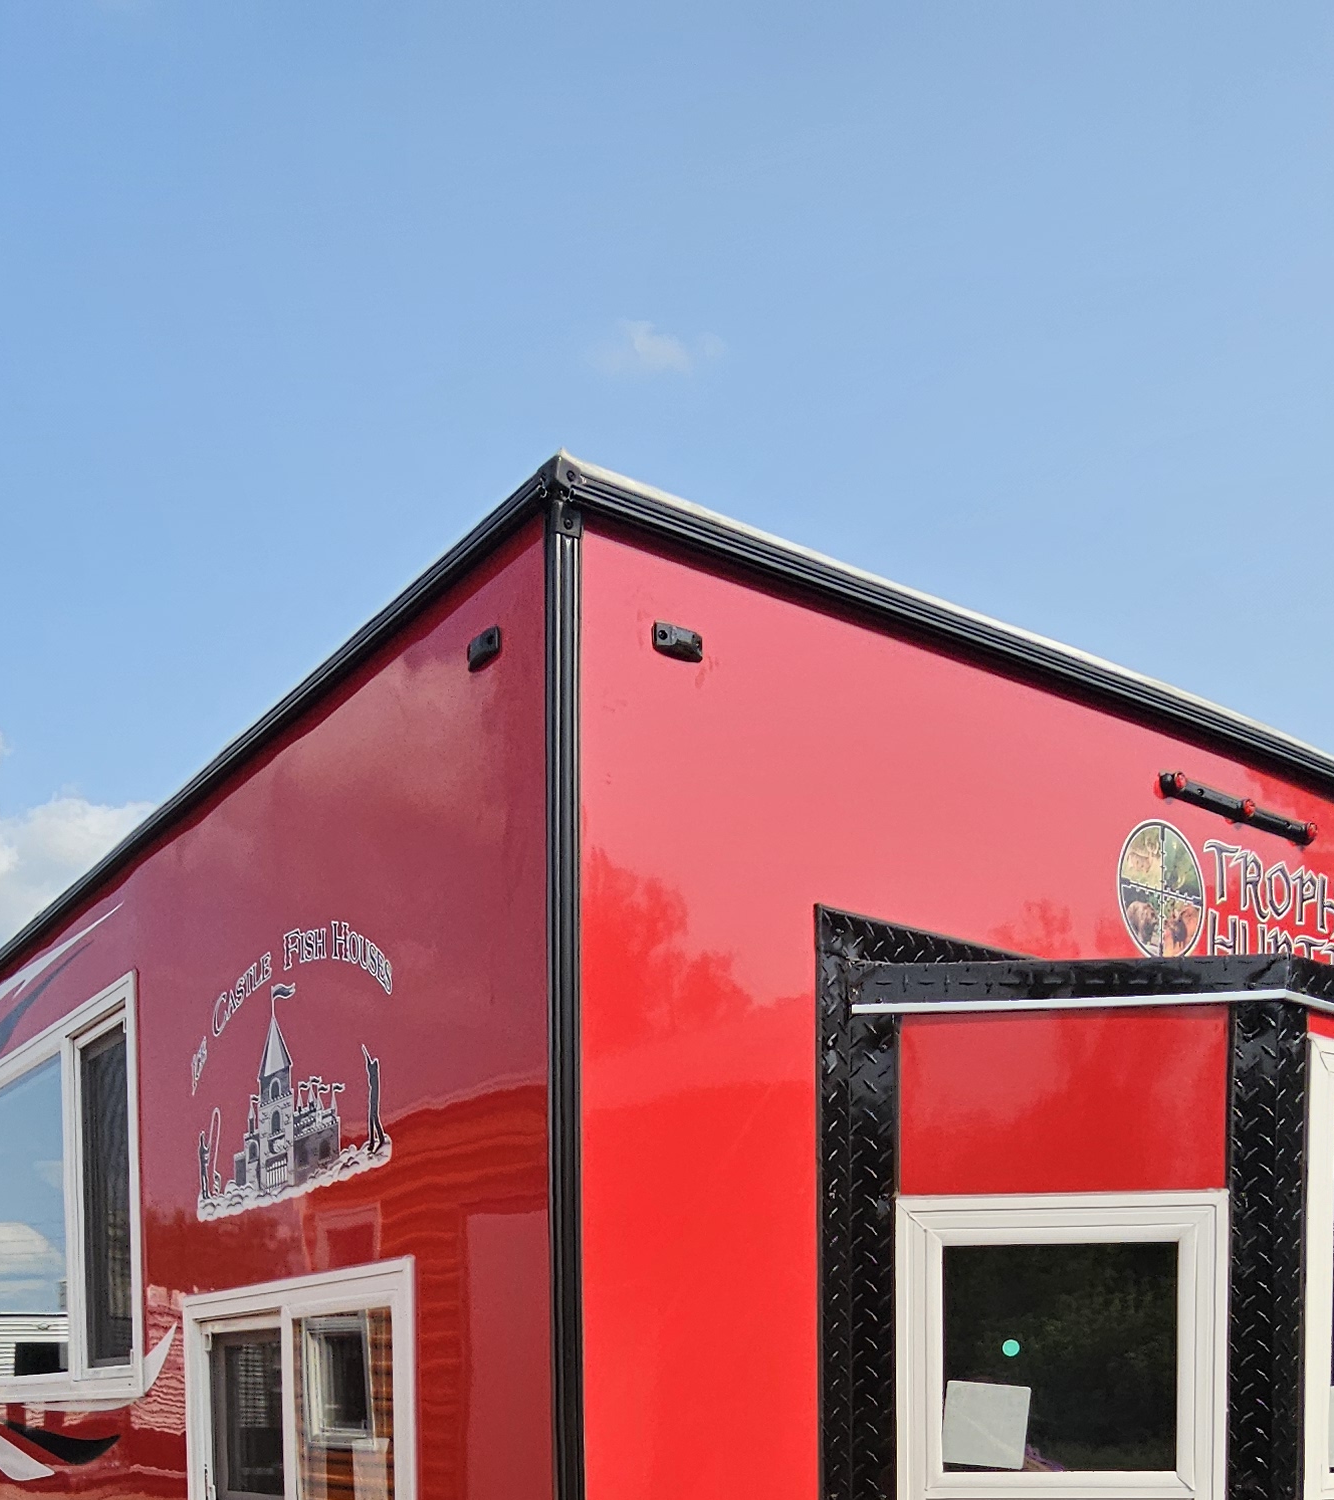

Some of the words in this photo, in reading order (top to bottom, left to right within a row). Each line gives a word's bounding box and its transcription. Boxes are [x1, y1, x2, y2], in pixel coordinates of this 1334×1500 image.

[212, 952, 272, 1036] CASTLE
[283, 928, 327, 971] FISH
[331, 920, 393, 995] HOUSES
